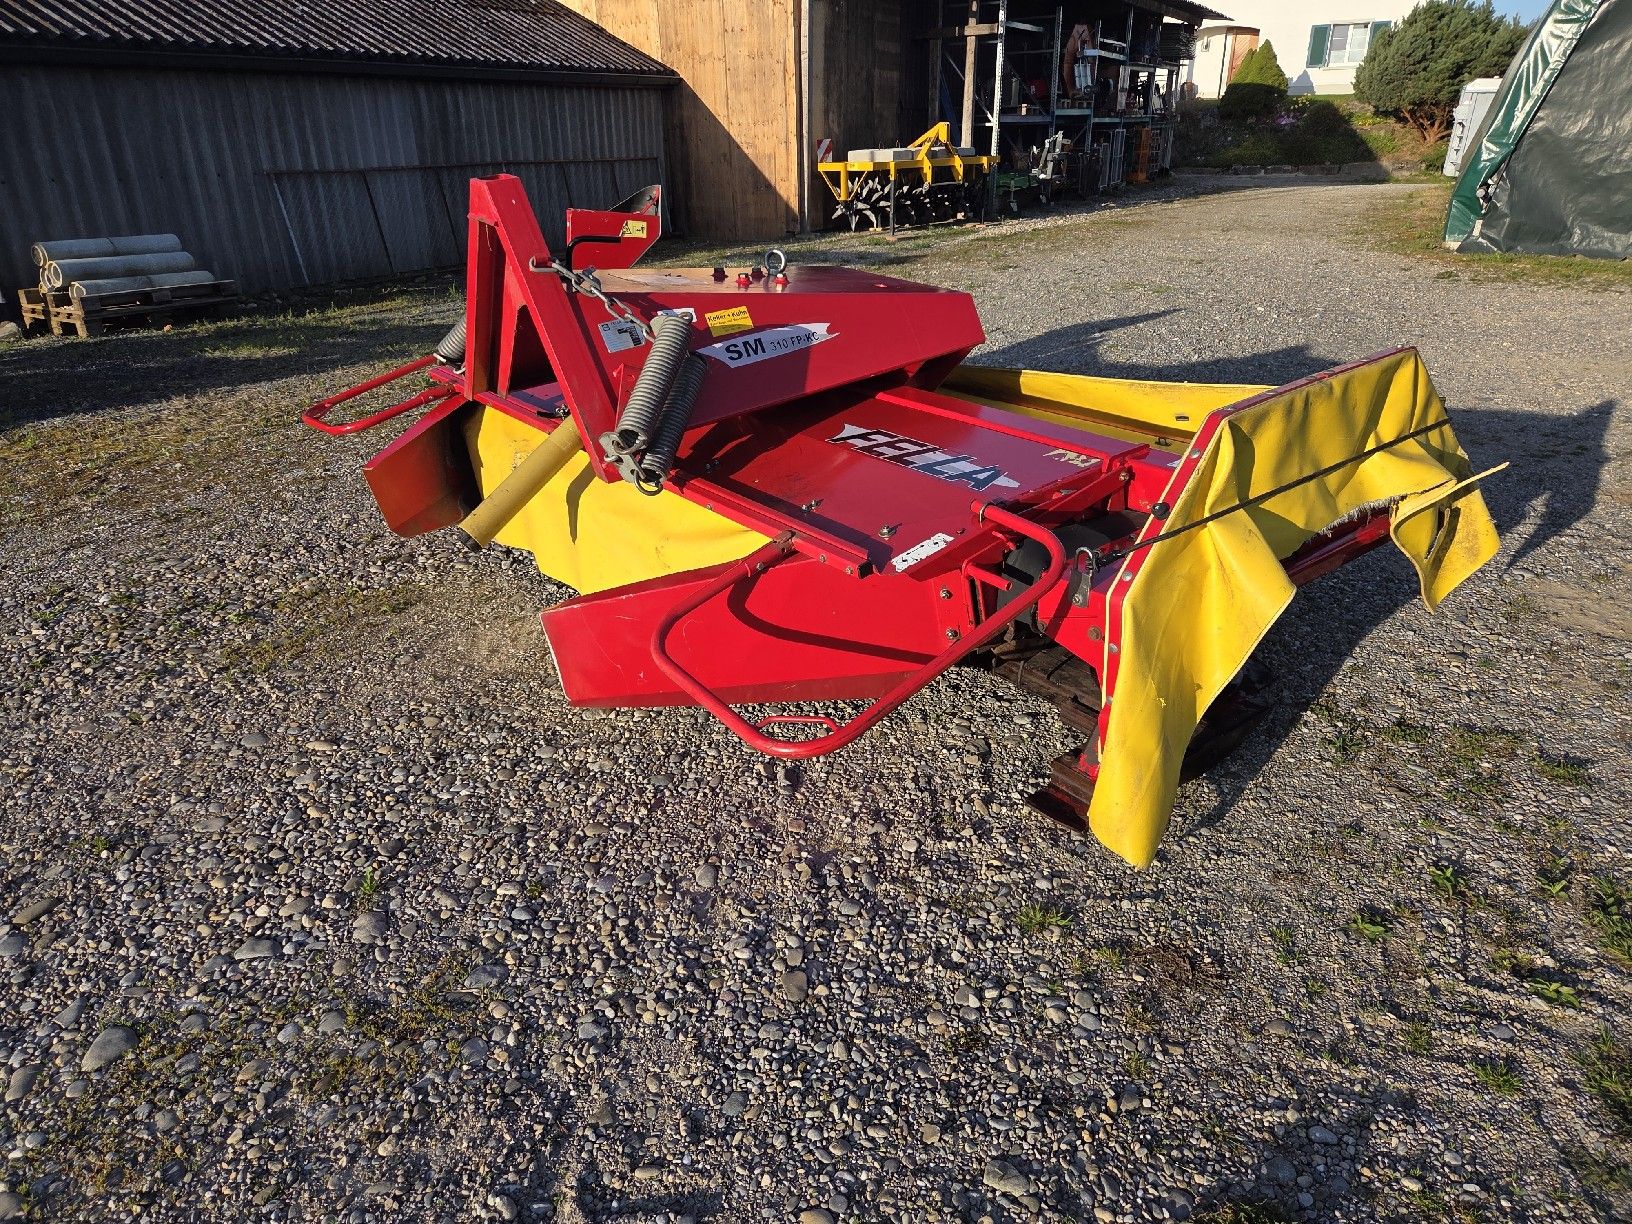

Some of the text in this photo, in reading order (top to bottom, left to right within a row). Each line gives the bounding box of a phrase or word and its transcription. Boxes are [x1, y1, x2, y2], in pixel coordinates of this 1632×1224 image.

[724, 337, 767, 361] SM
[769, 338, 788, 351] 310
[825, 428, 1008, 491] FELLA
